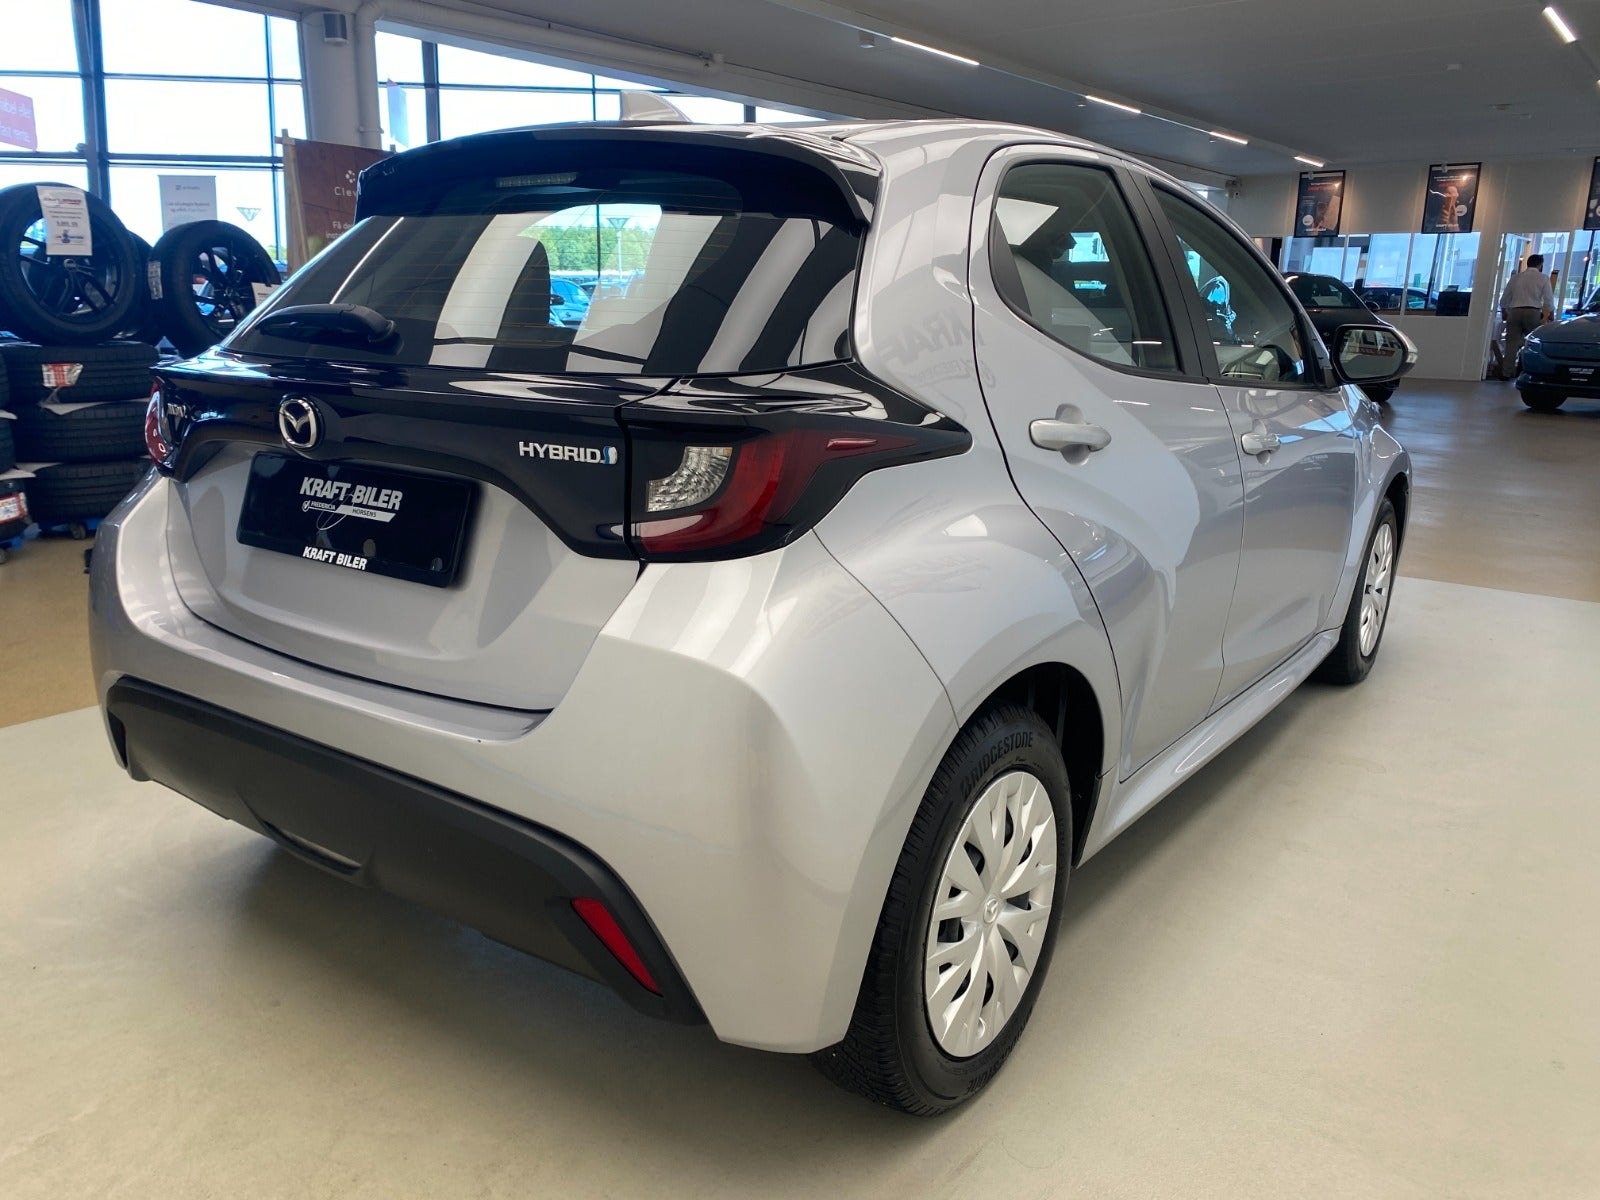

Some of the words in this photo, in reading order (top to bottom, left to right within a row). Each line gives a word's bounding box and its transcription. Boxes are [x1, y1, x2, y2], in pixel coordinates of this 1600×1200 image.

[518, 441, 602, 464] HYBRID
[299, 476, 352, 501] KRAFT
[351, 484, 403, 511] BILER
[352, 508, 377, 518] HORSENS
[302, 545, 337, 563] KRAFT
[335, 552, 368, 571] BILER
[960, 730, 1034, 801] BRIDGESTONE
